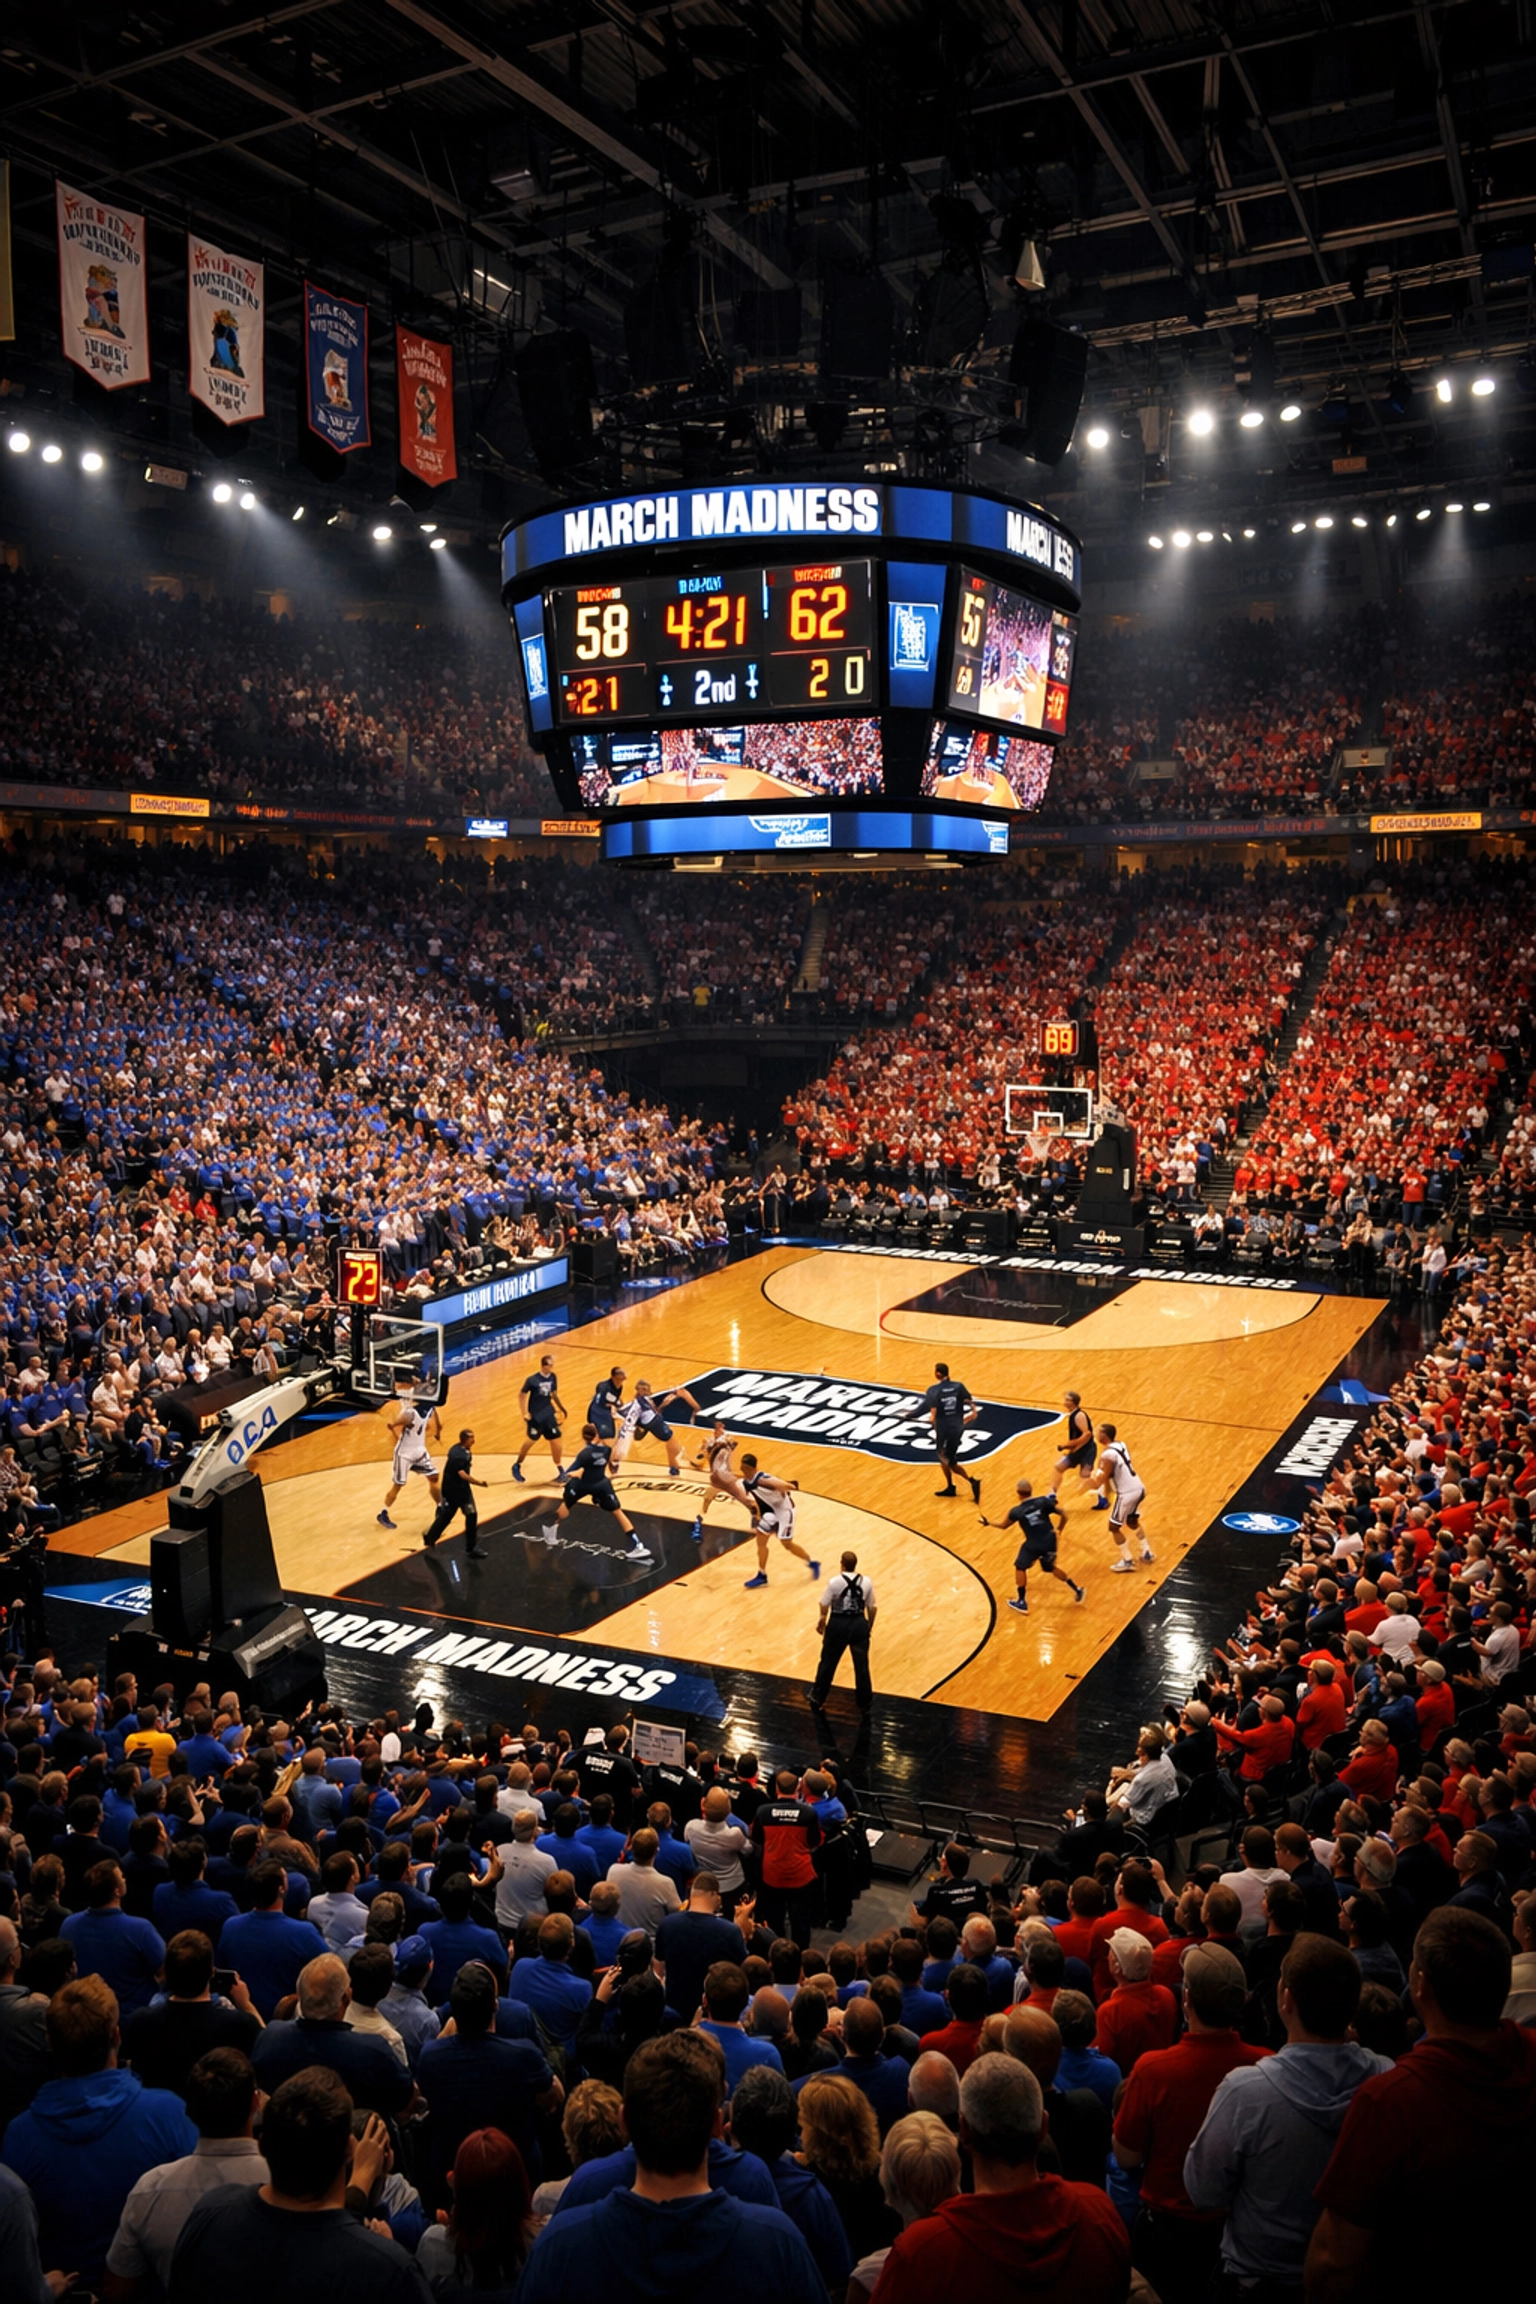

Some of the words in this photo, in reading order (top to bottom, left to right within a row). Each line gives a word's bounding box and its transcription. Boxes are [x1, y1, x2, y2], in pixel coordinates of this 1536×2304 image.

[564, 496, 679, 554] MARCH
[691, 488, 879, 537] MADNESS
[576, 604, 629, 660] 58
[666, 596, 746, 649] 4:21
[790, 585, 846, 640] 62
[695, 669, 736, 704] 2nd
[810, 658, 829, 698] 2
[845, 656, 864, 695] 0
[348, 1261, 378, 1301] 23
[1000, 1256, 1125, 1276] MARCH
[1128, 1268, 1298, 1290] MADNESS
[303, 1608, 433, 1656] ARCH
[412, 1631, 678, 1703] MADNESS
